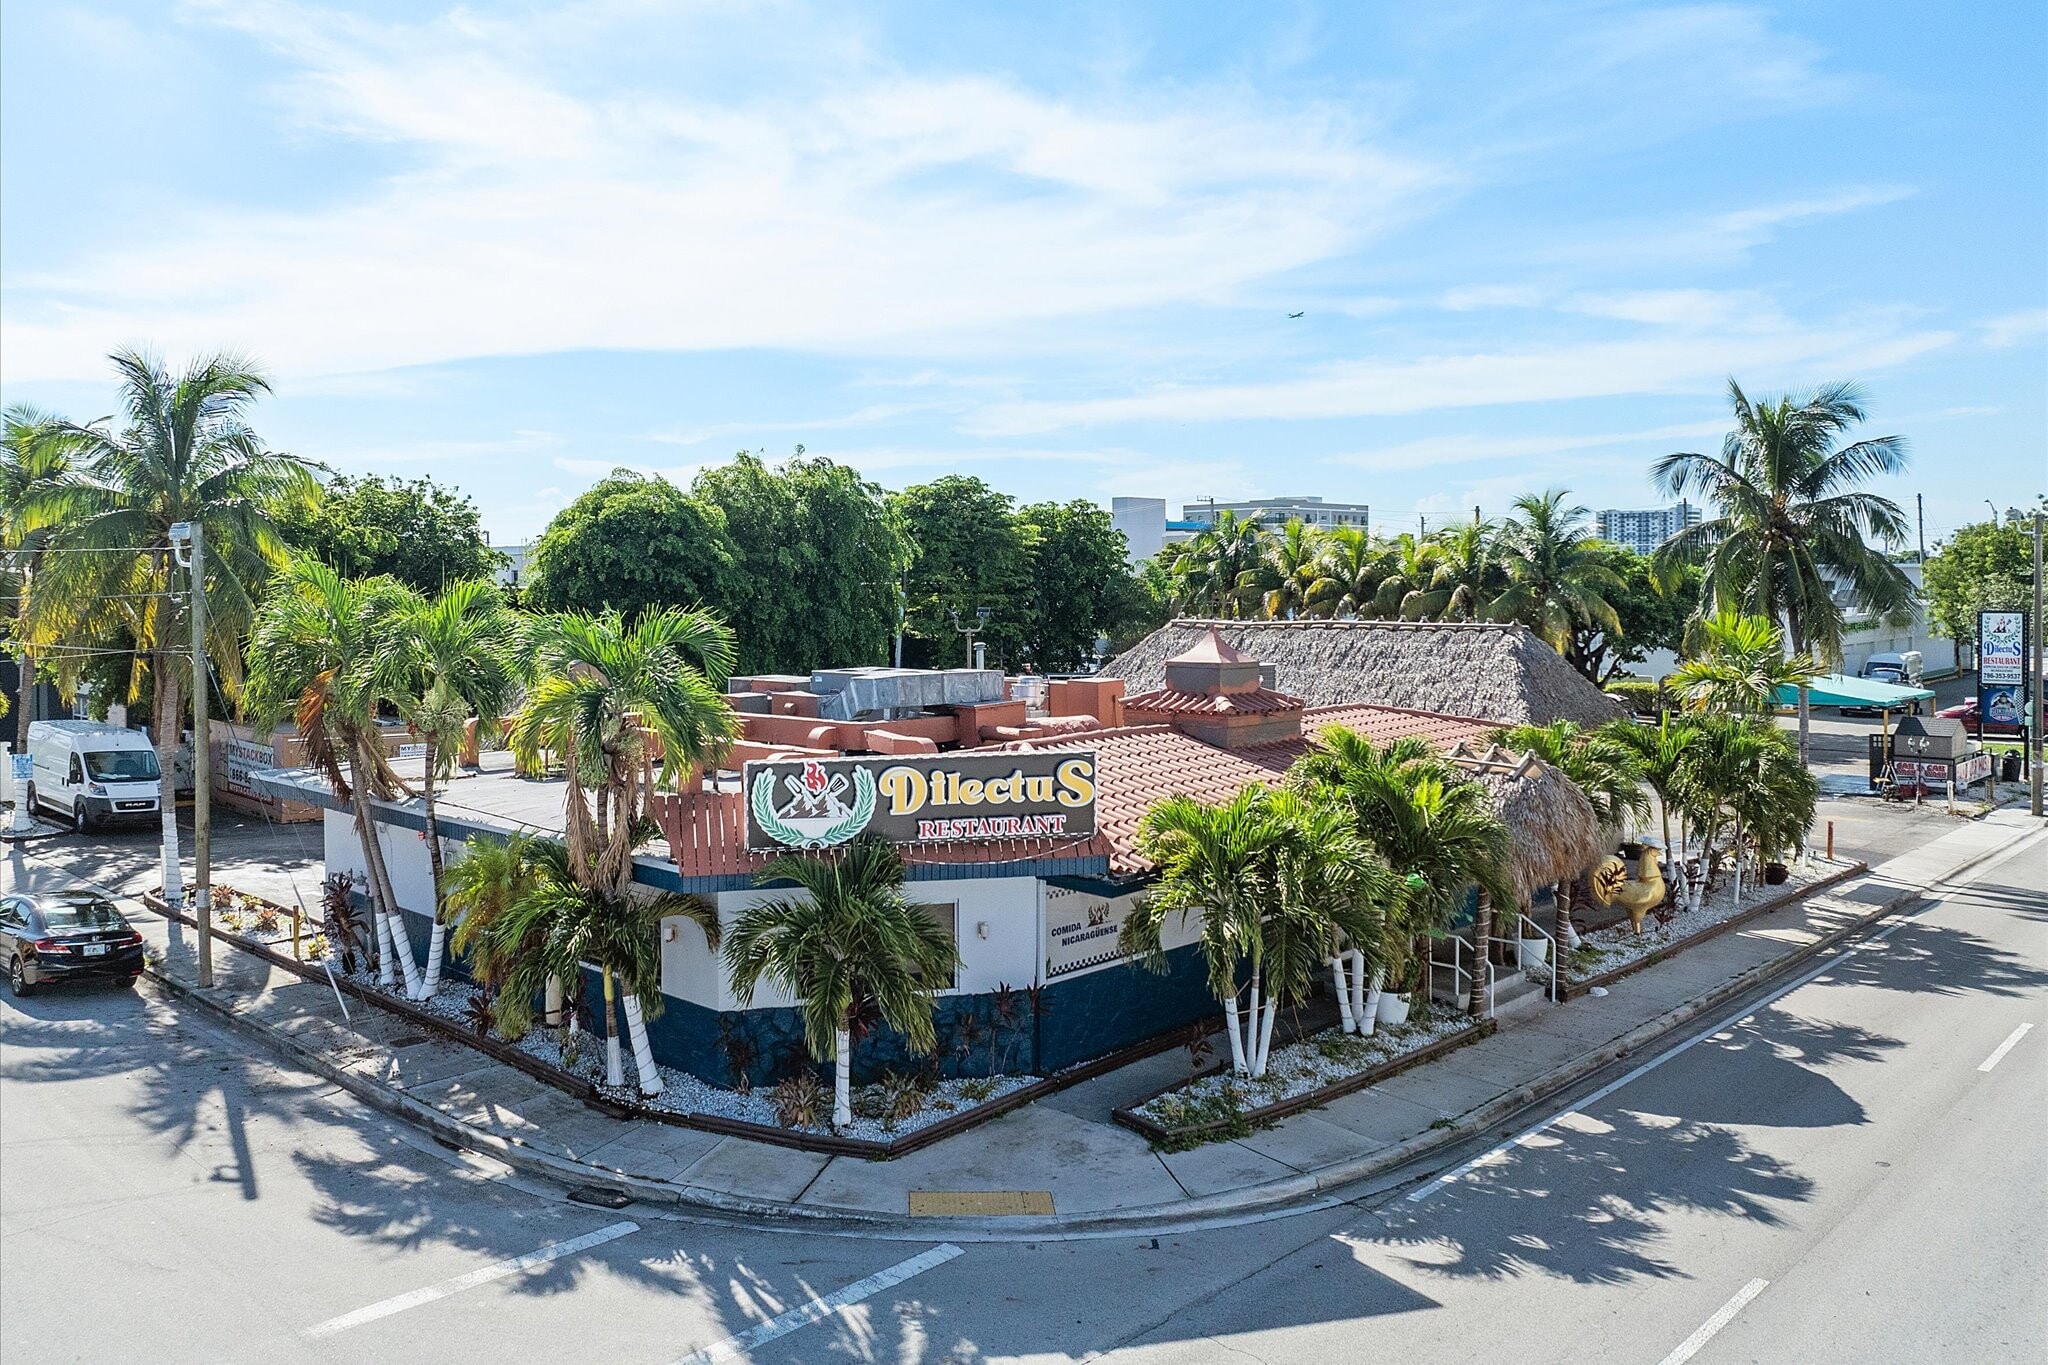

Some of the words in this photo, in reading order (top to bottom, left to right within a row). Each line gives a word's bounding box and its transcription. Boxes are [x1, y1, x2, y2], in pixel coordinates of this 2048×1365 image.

[1984, 657, 2021, 665] RESTAURANT
[229, 744, 273, 766] MYSTACKBOX
[918, 814, 1066, 839] RESTAURANT
[1051, 922, 1081, 937] COMIDA
[1061, 925, 1118, 946] NICARAGÜENSE
